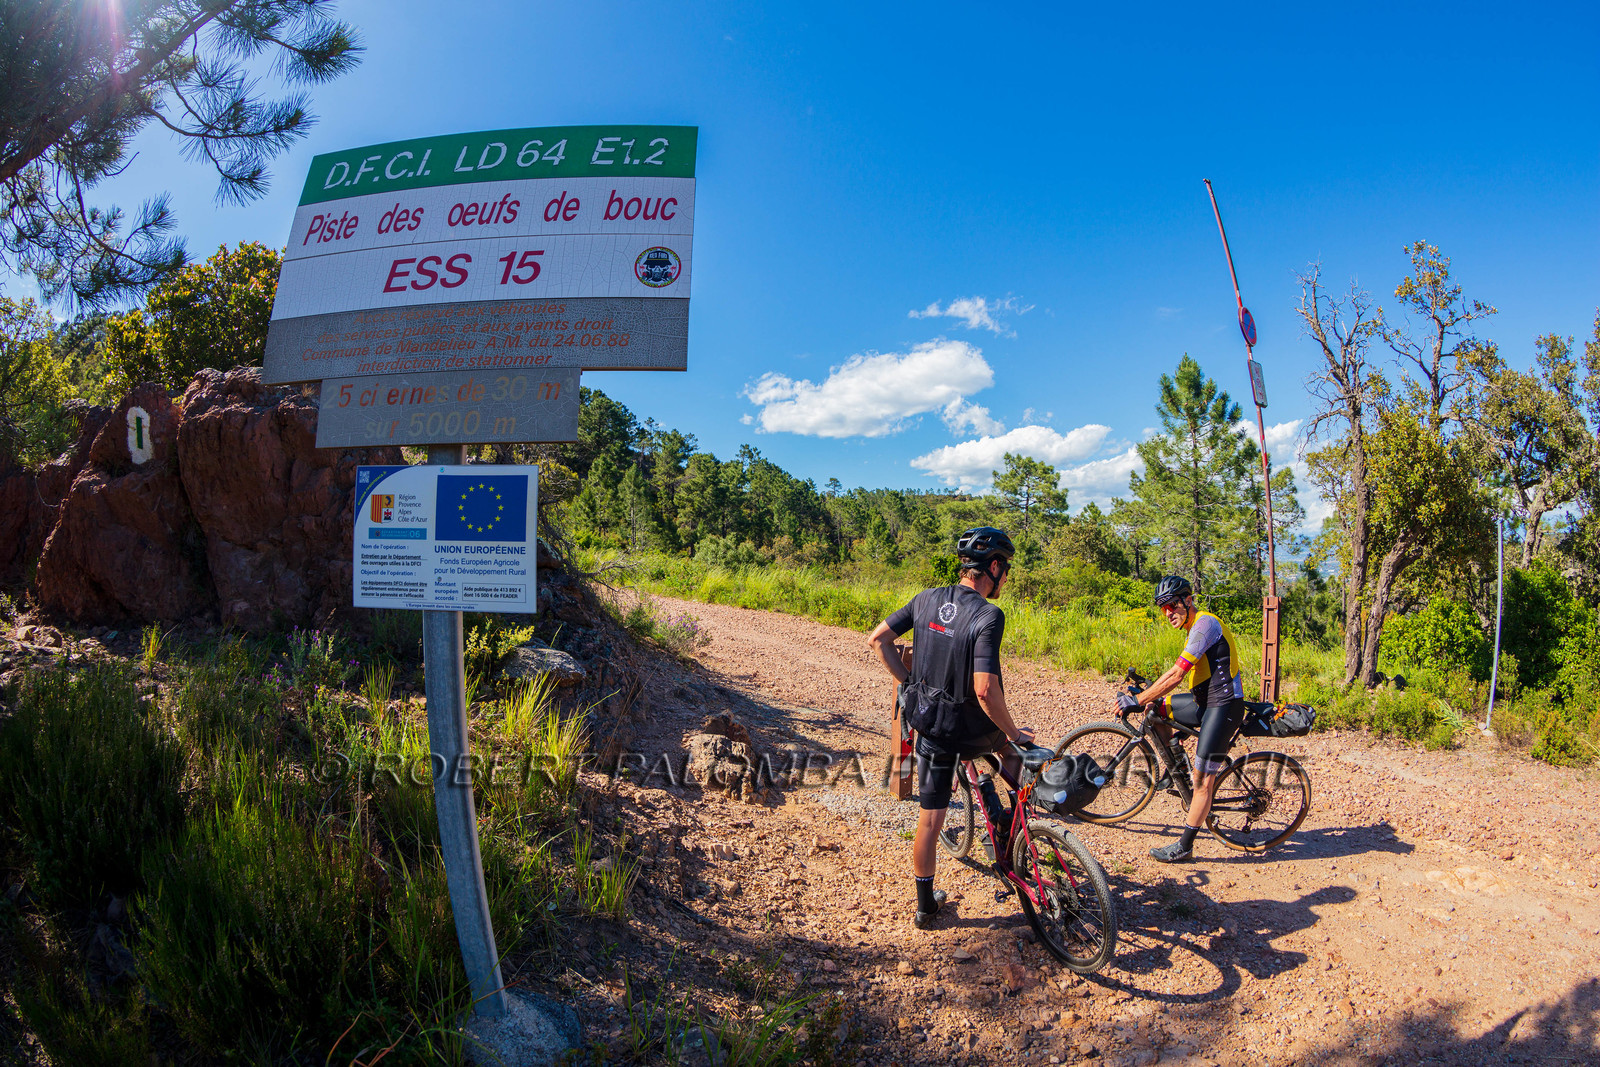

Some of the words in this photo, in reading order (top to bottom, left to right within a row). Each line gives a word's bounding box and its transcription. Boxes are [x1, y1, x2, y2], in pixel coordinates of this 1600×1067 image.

[323, 149, 432, 190] D.F.C.I.
[590, 137, 669, 165] E1.2
[303, 211, 359, 246] Piste
[377, 203, 424, 235] des
[448, 193, 520, 227] oeufs
[543, 191, 580, 222] de
[603, 189, 678, 221] bouc
[383, 253, 472, 293] ESS
[498, 250, 545, 285] 15
[401, 306, 455, 321] réservé
[457, 305, 485, 317] aux
[490, 301, 566, 316] véhicules
[318, 332, 340, 344] des
[343, 327, 402, 342] services
[401, 322, 456, 339] publics
[462, 322, 478, 333] et
[480, 323, 511, 333] aux
[514, 319, 569, 333] ayants
[574, 317, 614, 331] droit
[302, 345, 369, 361] Commune
[375, 342, 391, 355] de
[396, 337, 476, 354] Mandelieu
[484, 335, 522, 349] A.M.
[529, 335, 550, 348] du
[553, 333, 630, 347] 24.06.88
[357, 356, 441, 373] interdiction
[445, 355, 465, 368] de
[467, 352, 552, 367] stationner
[323, 384, 354, 409] 25
[359, 382, 451, 407] citernes
[457, 377, 486, 403] de
[491, 376, 527, 401] 30
[364, 419, 399, 439] sur
[408, 410, 481, 437] 5000
[492, 416, 516, 435] m
[399, 494, 416, 502] Région
[434, 545, 462, 554] UNION
[464, 544, 526, 554] EUROPÉENNE
[461, 558, 492, 566] Européen
[493, 559, 520, 567] Agricole
[457, 567, 507, 576] Développement
